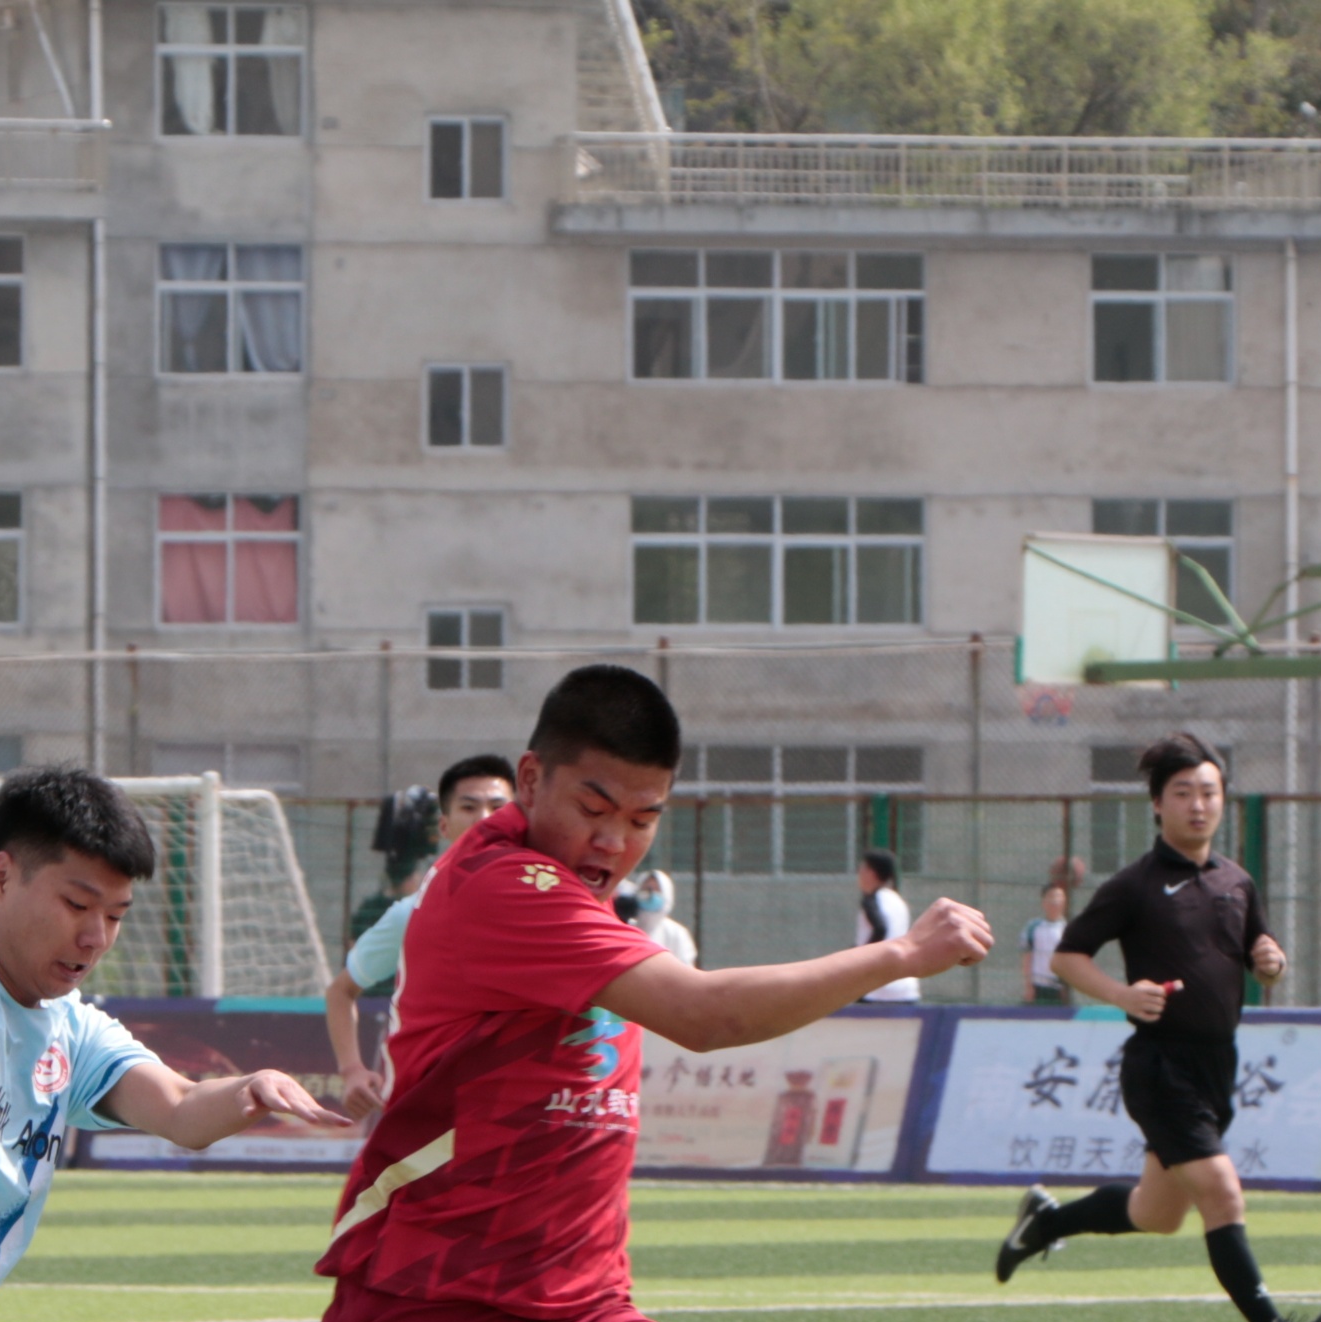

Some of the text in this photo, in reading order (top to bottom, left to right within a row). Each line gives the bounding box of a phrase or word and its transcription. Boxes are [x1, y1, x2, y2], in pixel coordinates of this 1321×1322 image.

[11, 1119, 62, 1165] Alon
[1009, 1135, 1270, 1173] 饮用天然水
